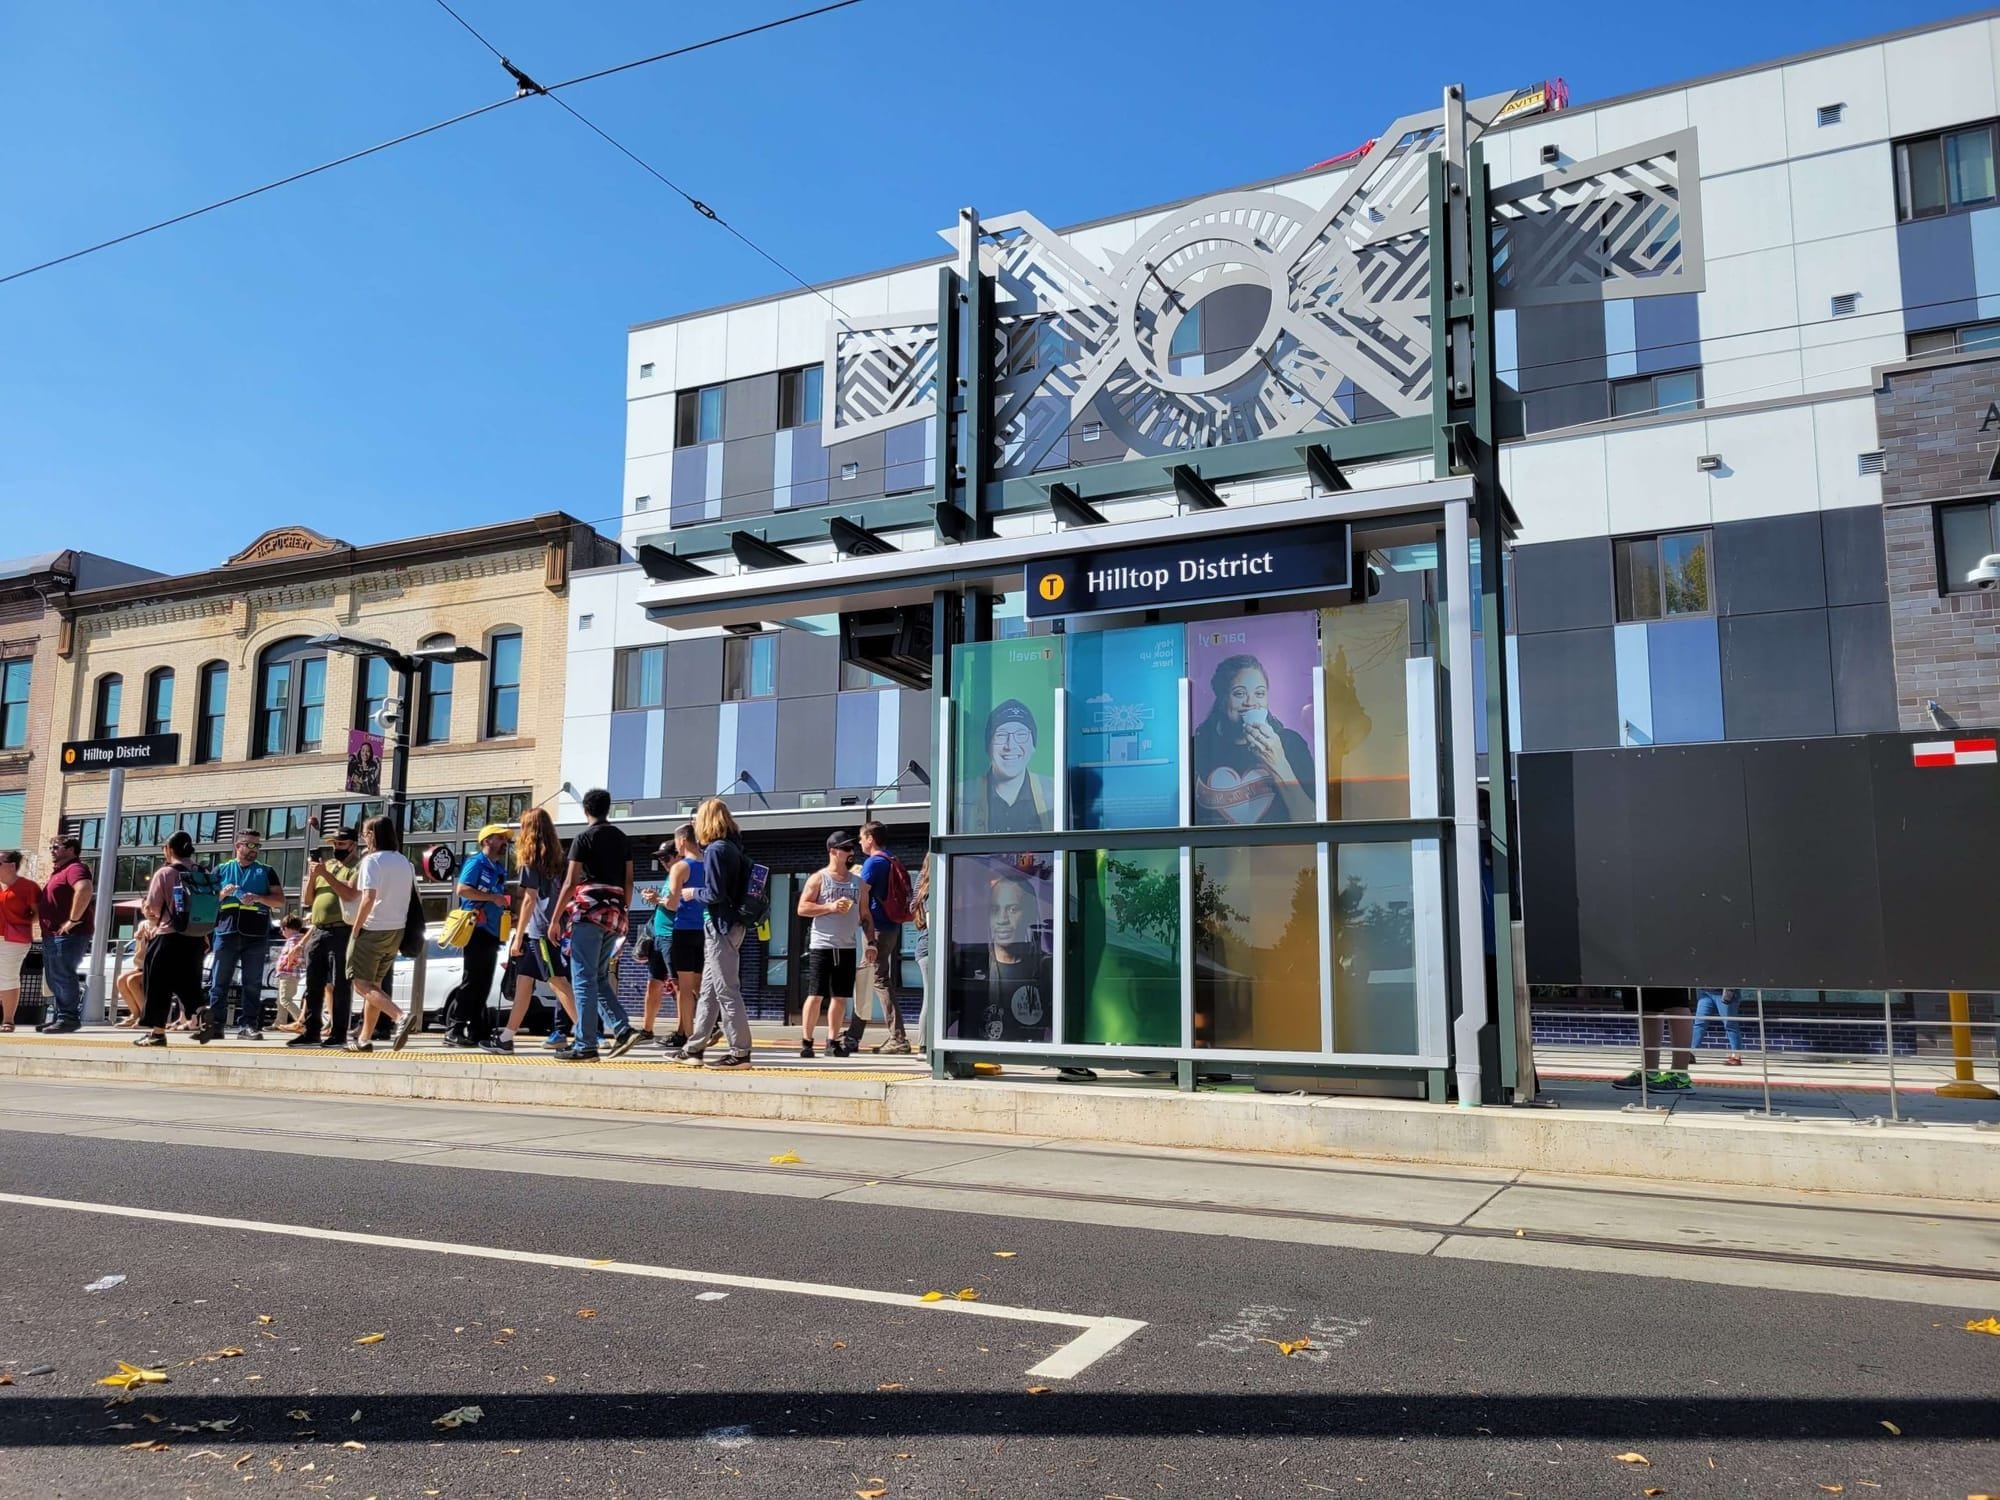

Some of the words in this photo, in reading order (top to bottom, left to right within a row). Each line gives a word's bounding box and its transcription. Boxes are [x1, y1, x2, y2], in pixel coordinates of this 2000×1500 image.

[1087, 567, 1169, 593] Hilltop
[1178, 551, 1274, 583] District
[83, 747, 114, 762] Hilltop
[116, 744, 151, 759] District
